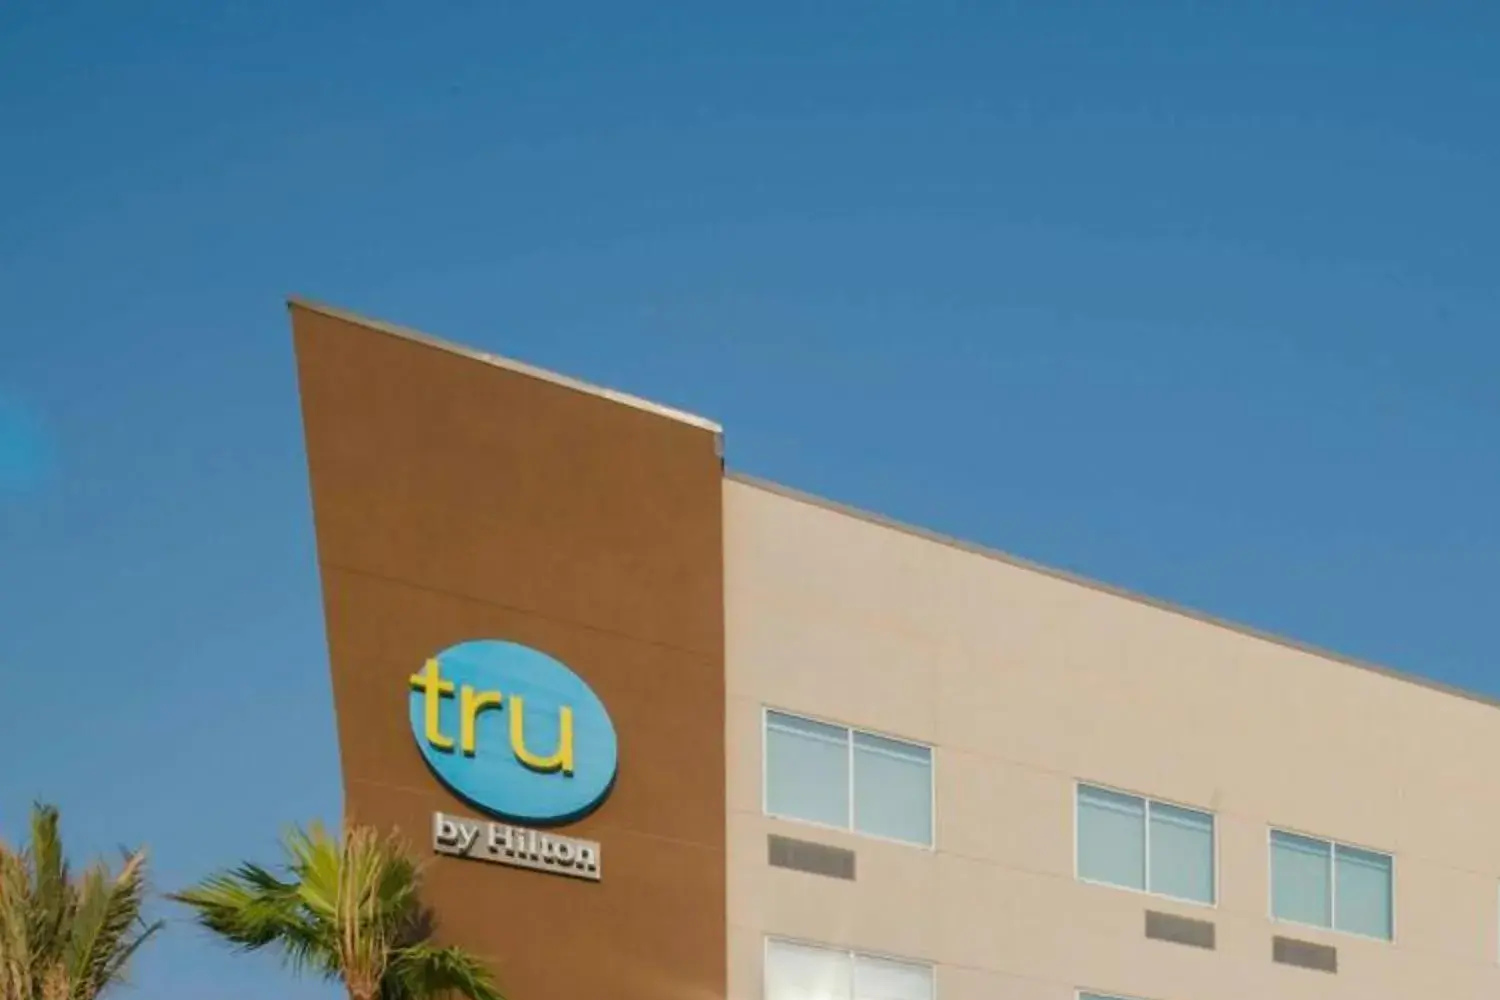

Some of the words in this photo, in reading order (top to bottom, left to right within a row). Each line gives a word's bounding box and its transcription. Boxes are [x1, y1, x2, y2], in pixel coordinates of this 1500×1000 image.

[409, 658, 575, 775] tru
[435, 811, 480, 855] by
[487, 822, 598, 869] Hilton
